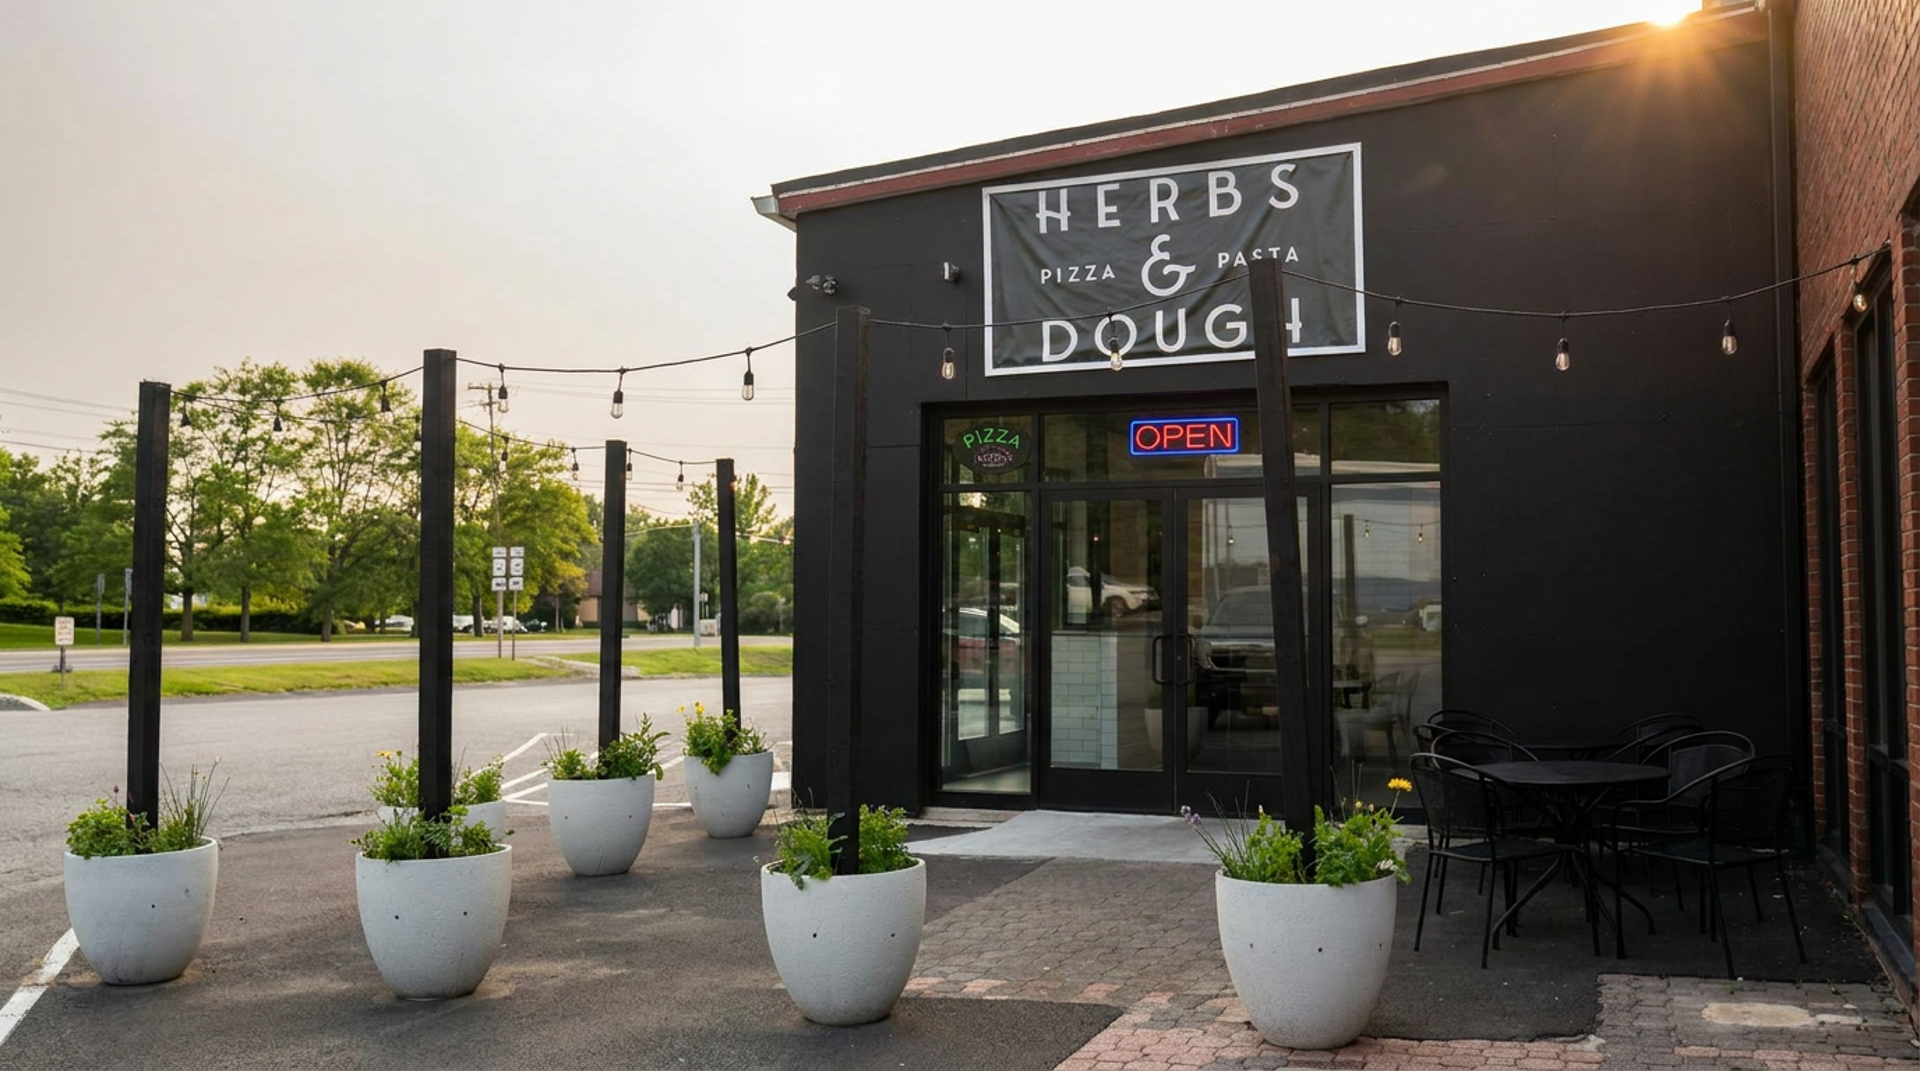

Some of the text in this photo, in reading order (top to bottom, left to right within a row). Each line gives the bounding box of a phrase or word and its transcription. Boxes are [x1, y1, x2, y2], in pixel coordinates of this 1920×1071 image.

[1036, 163, 1299, 234] HERBS
[1041, 234, 1299, 297] PIZZA & PASTA
[963, 428, 1020, 449] PIZZA
[1135, 423, 1232, 449] OPEN
